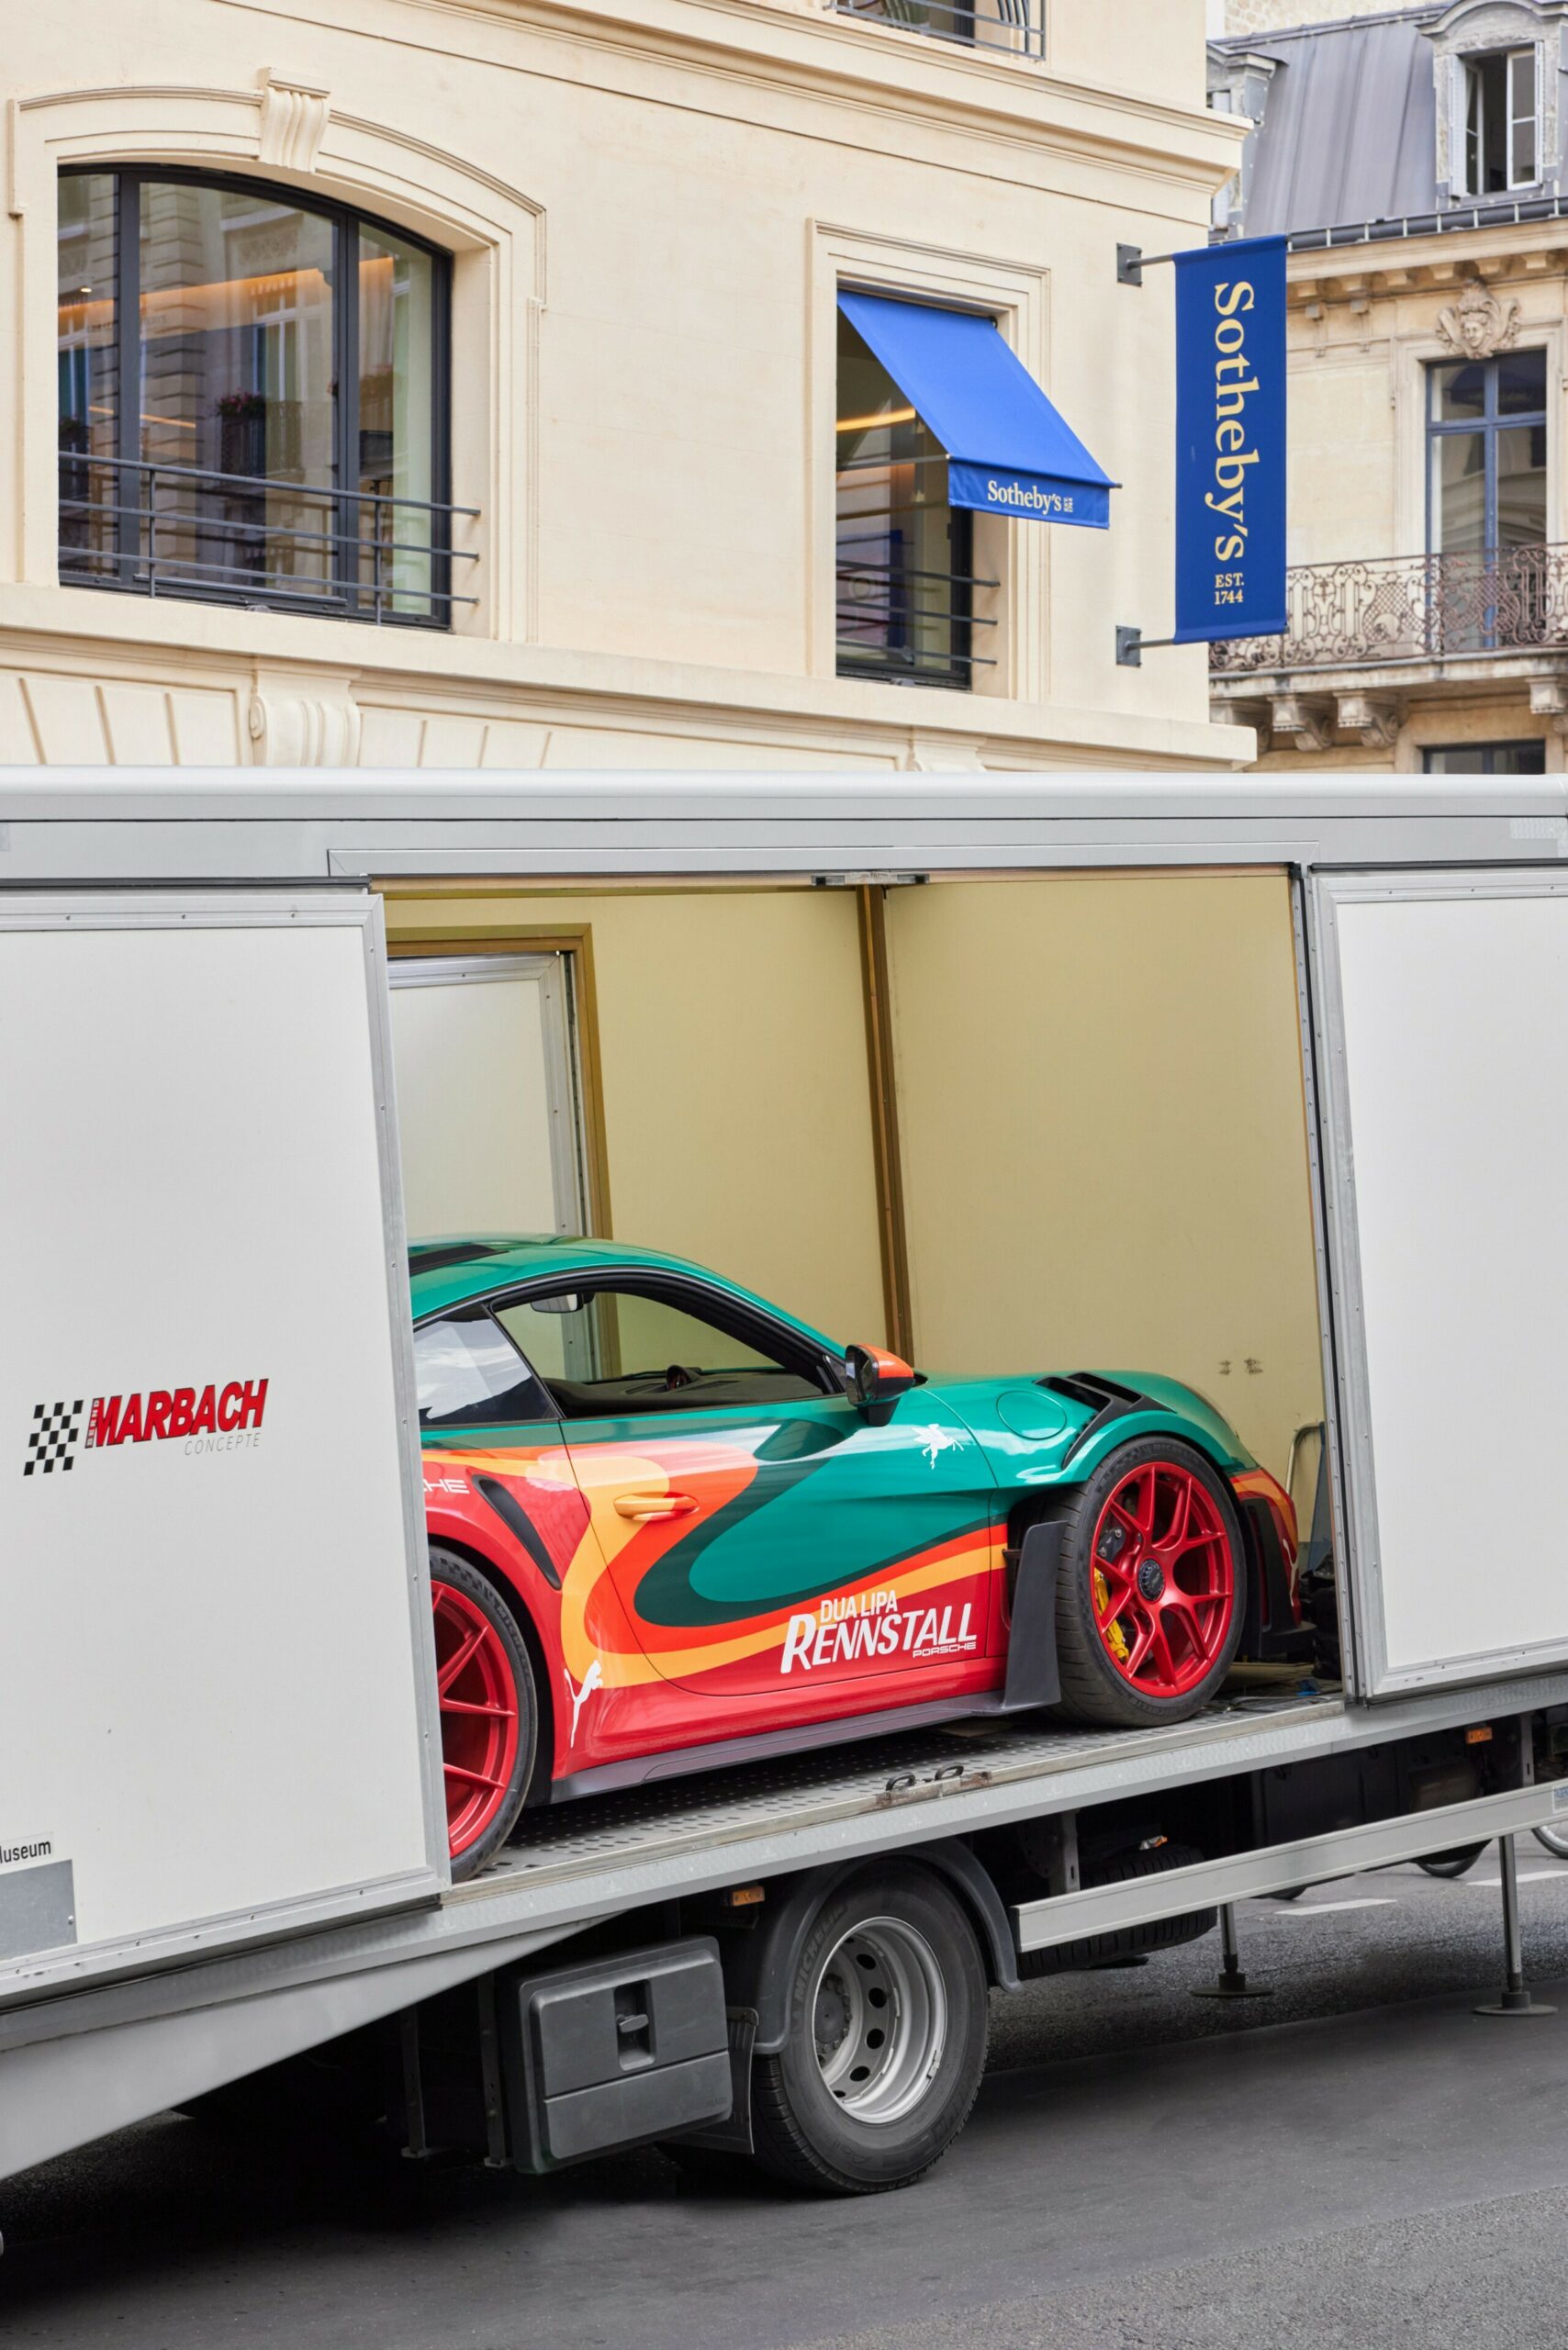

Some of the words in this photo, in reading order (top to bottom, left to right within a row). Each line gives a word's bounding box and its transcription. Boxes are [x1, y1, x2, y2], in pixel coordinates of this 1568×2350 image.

[1204, 281, 1260, 562] Sotheby's
[988, 479, 1062, 515] Sotheby's
[1215, 573, 1245, 588] EST.
[1215, 589, 1243, 605] 1744
[86, 1399, 100, 1447] BERND
[95, 1379, 269, 1447] MARBACH
[185, 1432, 261, 1456] CONCEPTE
[423, 1478, 470, 1494] HE
[820, 1595, 857, 1624] DUA
[860, 1590, 898, 1617] LIPA
[780, 1603, 977, 1674] RENNSTALL
[913, 1641, 977, 1659] PORSCHE
[0, 1841, 51, 1863] useum
